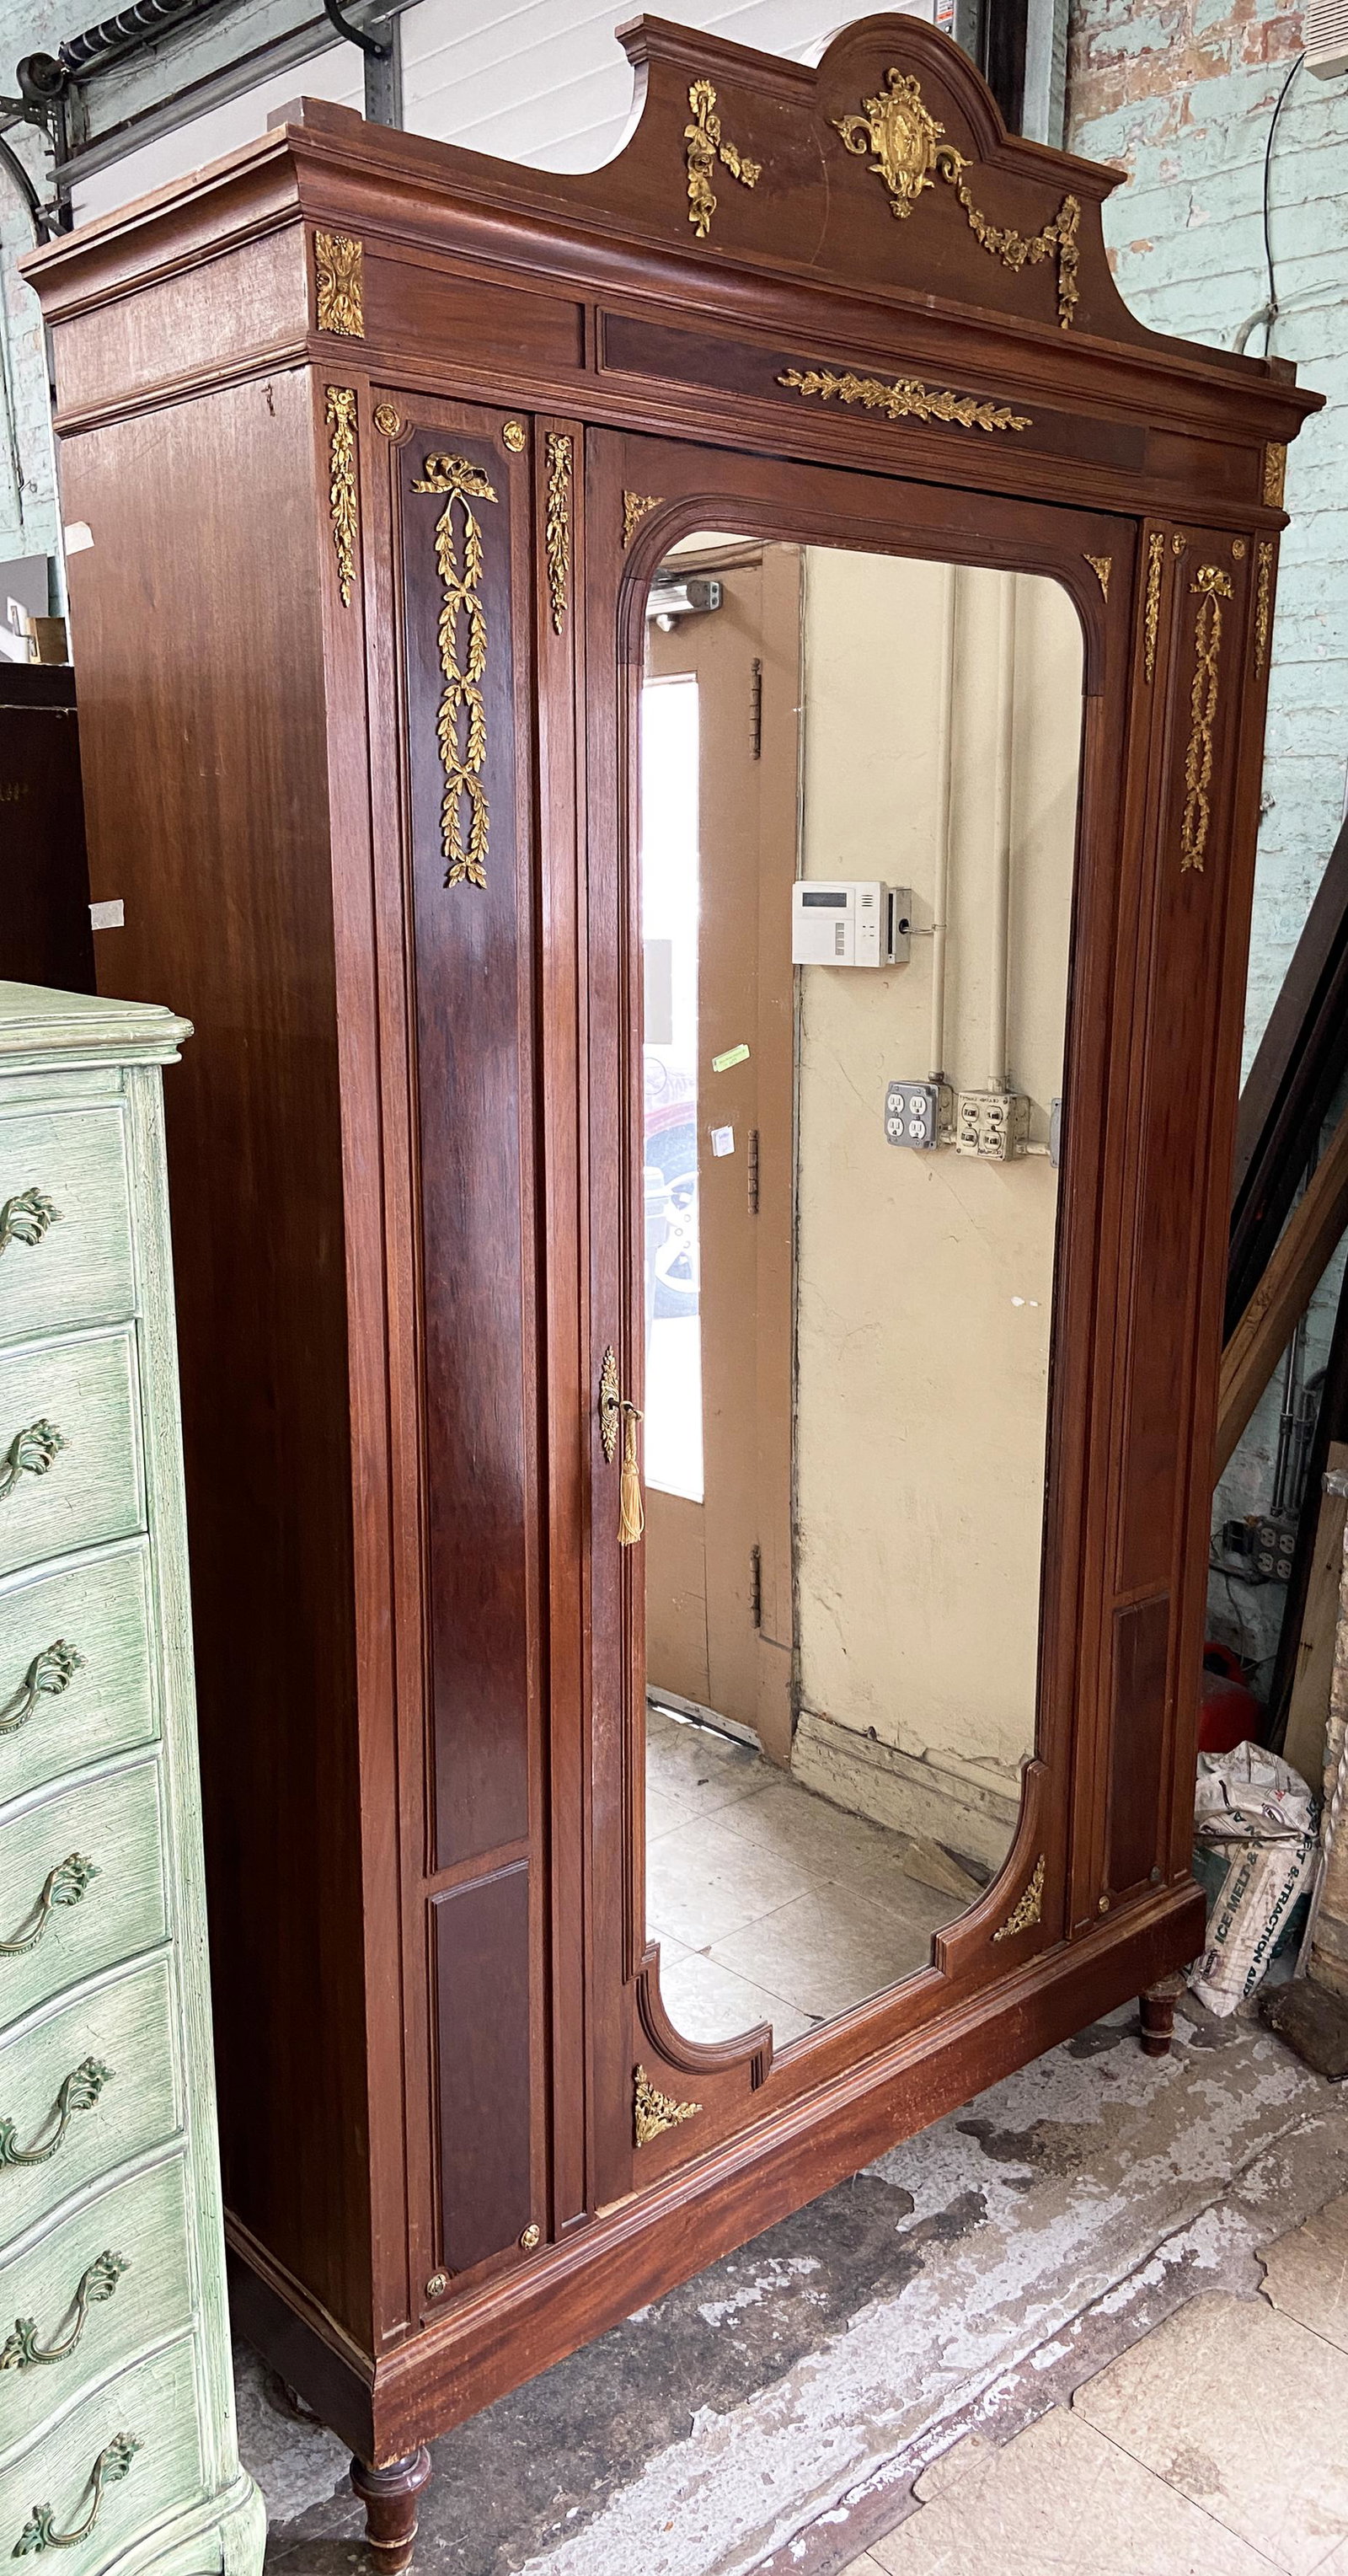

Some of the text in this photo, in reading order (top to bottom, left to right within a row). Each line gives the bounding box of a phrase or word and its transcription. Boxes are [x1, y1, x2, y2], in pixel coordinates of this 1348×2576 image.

[1214, 1912, 1233, 1945] ICE
[1227, 1863, 1251, 1913] MELT
[1247, 1851, 1259, 1866] &
[1290, 1866, 1299, 1878] &
[1253, 1882, 1295, 1964] TRACTION
[1243, 1966, 1257, 1997] AID
